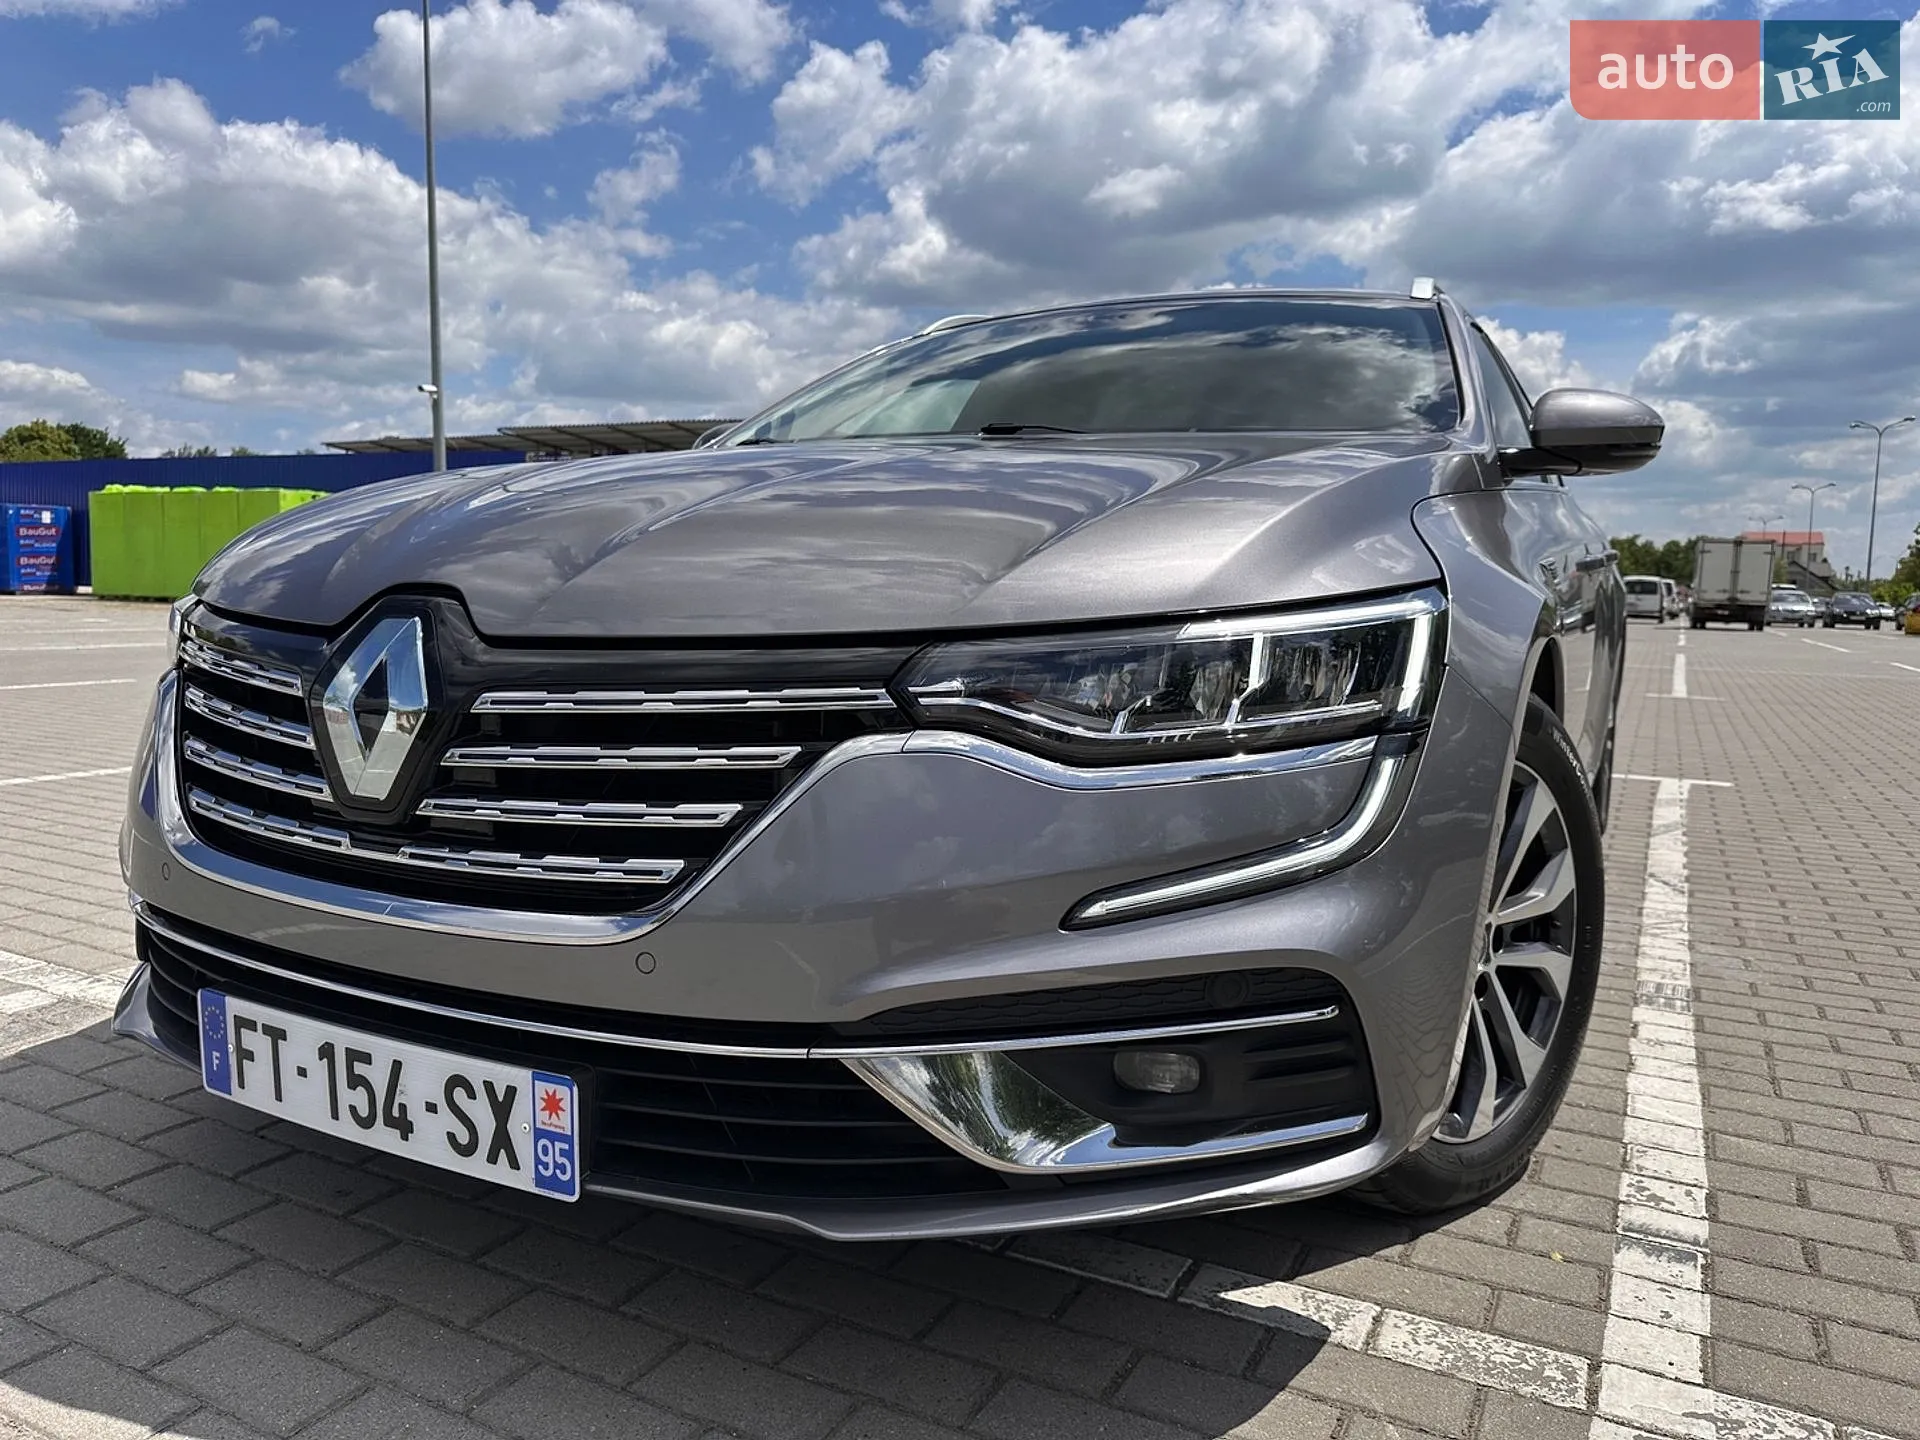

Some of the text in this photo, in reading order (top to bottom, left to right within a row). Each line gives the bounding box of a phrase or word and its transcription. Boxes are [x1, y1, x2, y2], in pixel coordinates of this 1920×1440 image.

[19, 527, 57, 536] BauGut
[212, 1051, 220, 1071] F
[233, 1014, 521, 1171] FT-154-SX
[537, 1138, 572, 1182] 95
